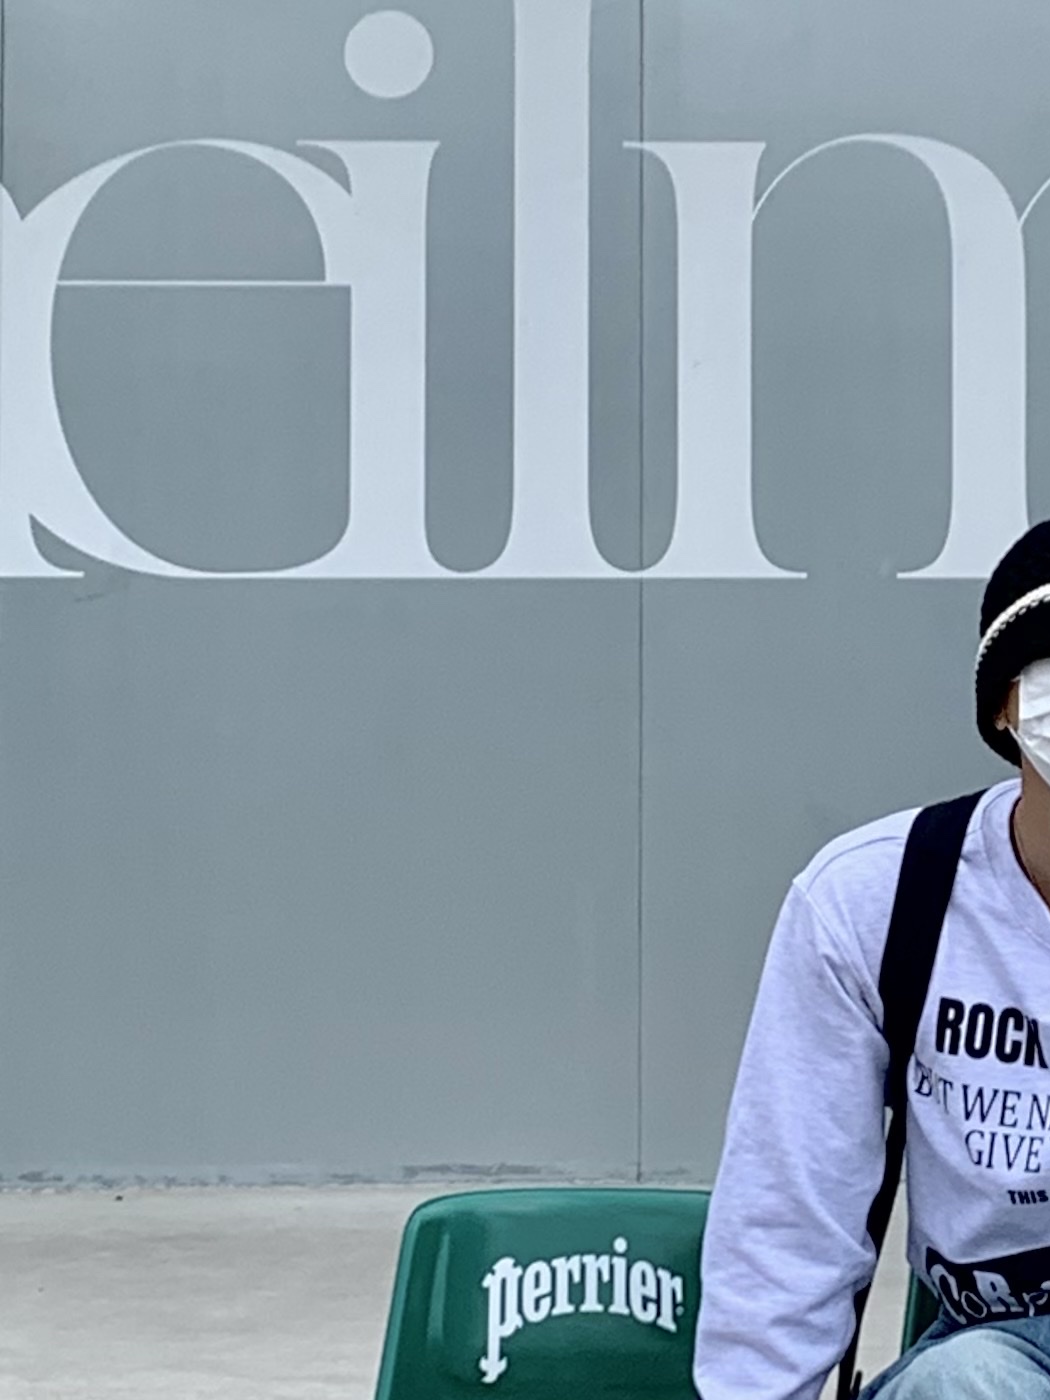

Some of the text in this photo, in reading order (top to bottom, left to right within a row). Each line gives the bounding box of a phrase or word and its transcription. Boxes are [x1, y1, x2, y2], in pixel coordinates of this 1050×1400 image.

[935, 997, 1049, 1069] ROCK
[961, 1084, 1022, 1128] WE
[965, 1129, 1044, 1173] GIVE
[1007, 1190, 1048, 1205] THIS
